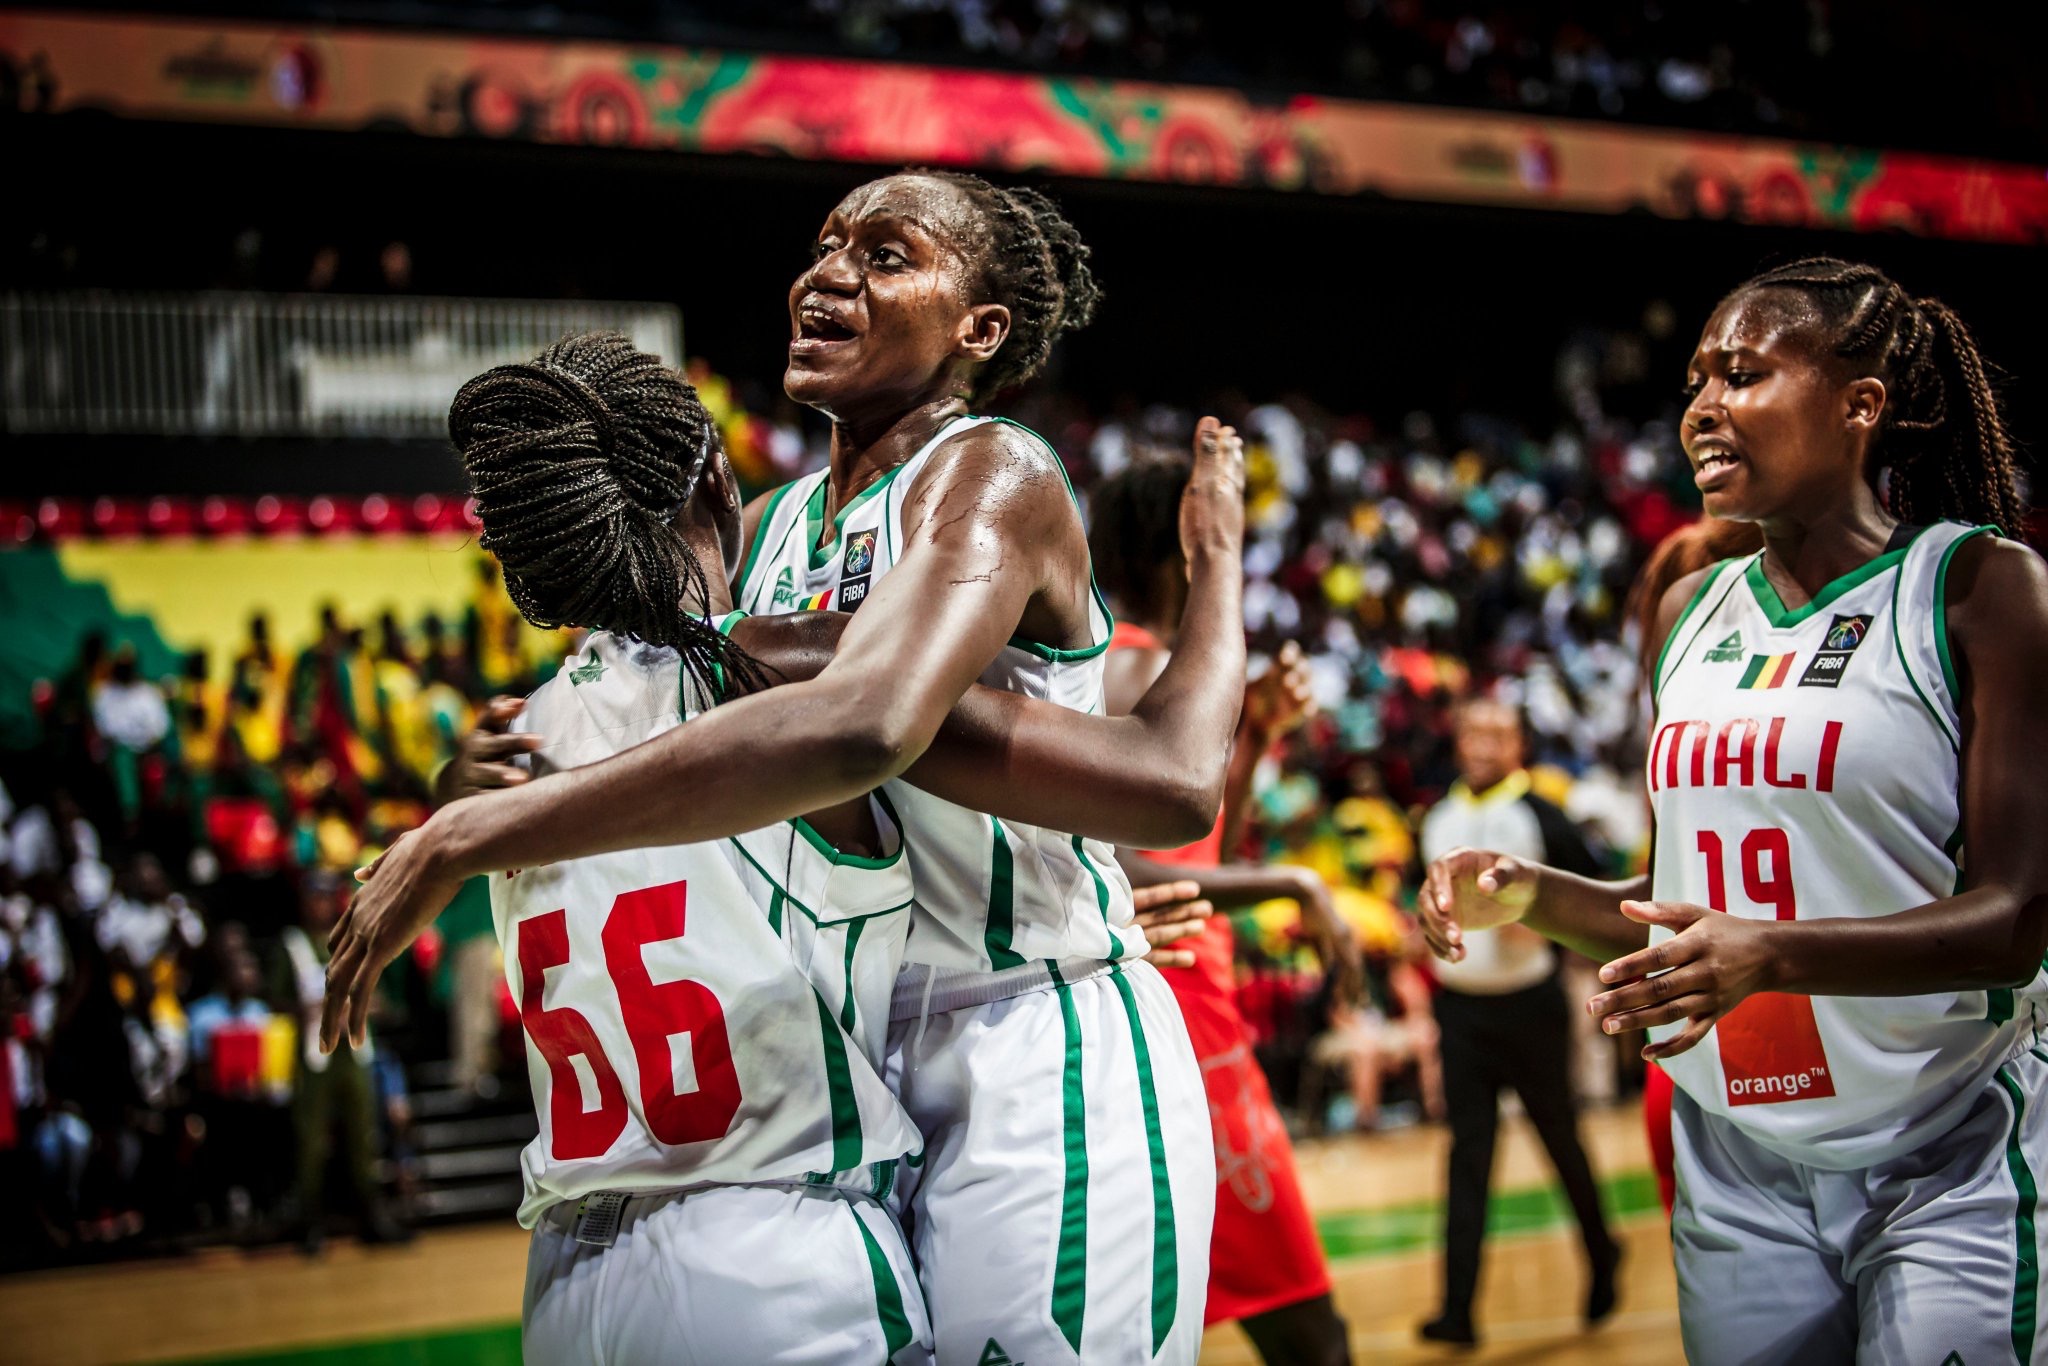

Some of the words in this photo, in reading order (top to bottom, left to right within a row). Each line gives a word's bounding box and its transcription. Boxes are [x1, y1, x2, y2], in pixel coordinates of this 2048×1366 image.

[842, 582, 866, 604] FIBA
[1813, 656, 1845, 670] FIBA
[1651, 717, 1843, 793] MALI
[1697, 828, 1796, 921] 19
[518, 879, 742, 1160] 66
